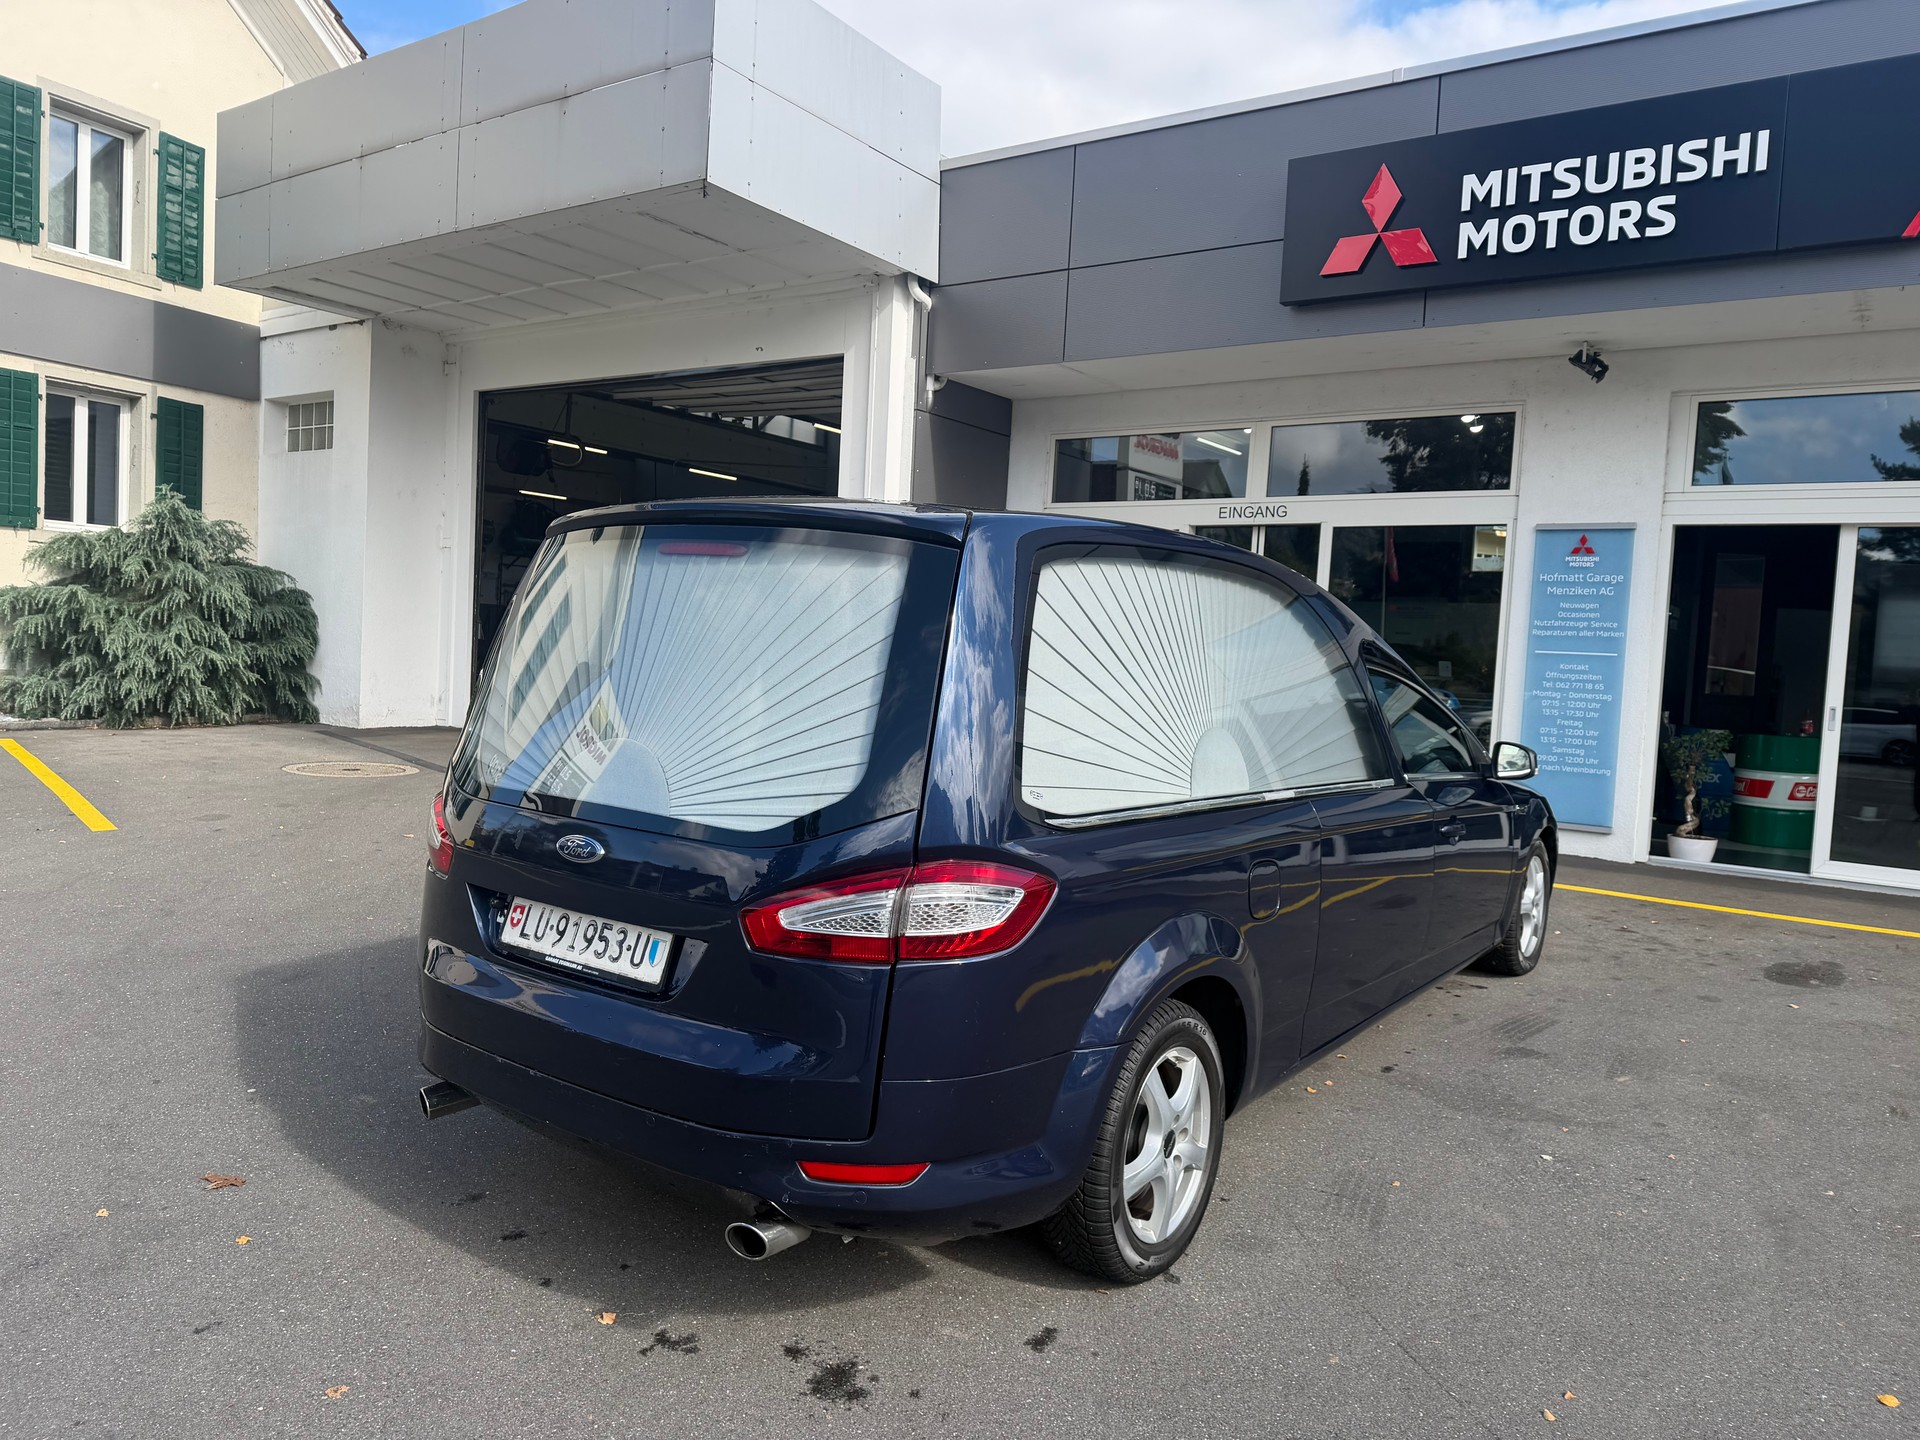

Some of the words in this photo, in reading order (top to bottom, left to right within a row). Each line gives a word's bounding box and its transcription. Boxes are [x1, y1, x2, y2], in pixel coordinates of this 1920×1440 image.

[1460, 128, 1771, 211] MITSUBISHI
[1457, 194, 1678, 260] MOTORS
[1218, 505, 1288, 519] EINGANG
[1540, 573, 1584, 582] Hofmatt
[1586, 573, 1624, 584] Garage
[1547, 586, 1597, 596] Menziken
[1599, 586, 1614, 596] AG
[1560, 602, 1600, 610] Neuwagen
[1534, 620, 1589, 628] Nutzfahrzeuge
[1532, 628, 1577, 636] Reparaturen
[1546, 671, 1602, 680] Öffnungszeiten
[1532, 690, 1560, 699] Montag
[1568, 692, 1612, 702] Donnerstag
[1556, 719, 1583, 728] Freitag
[1552, 746, 1585, 756] Samstag
[1561, 765, 1611, 776] Vereinbarung
[564, 839, 591, 857] Ford
